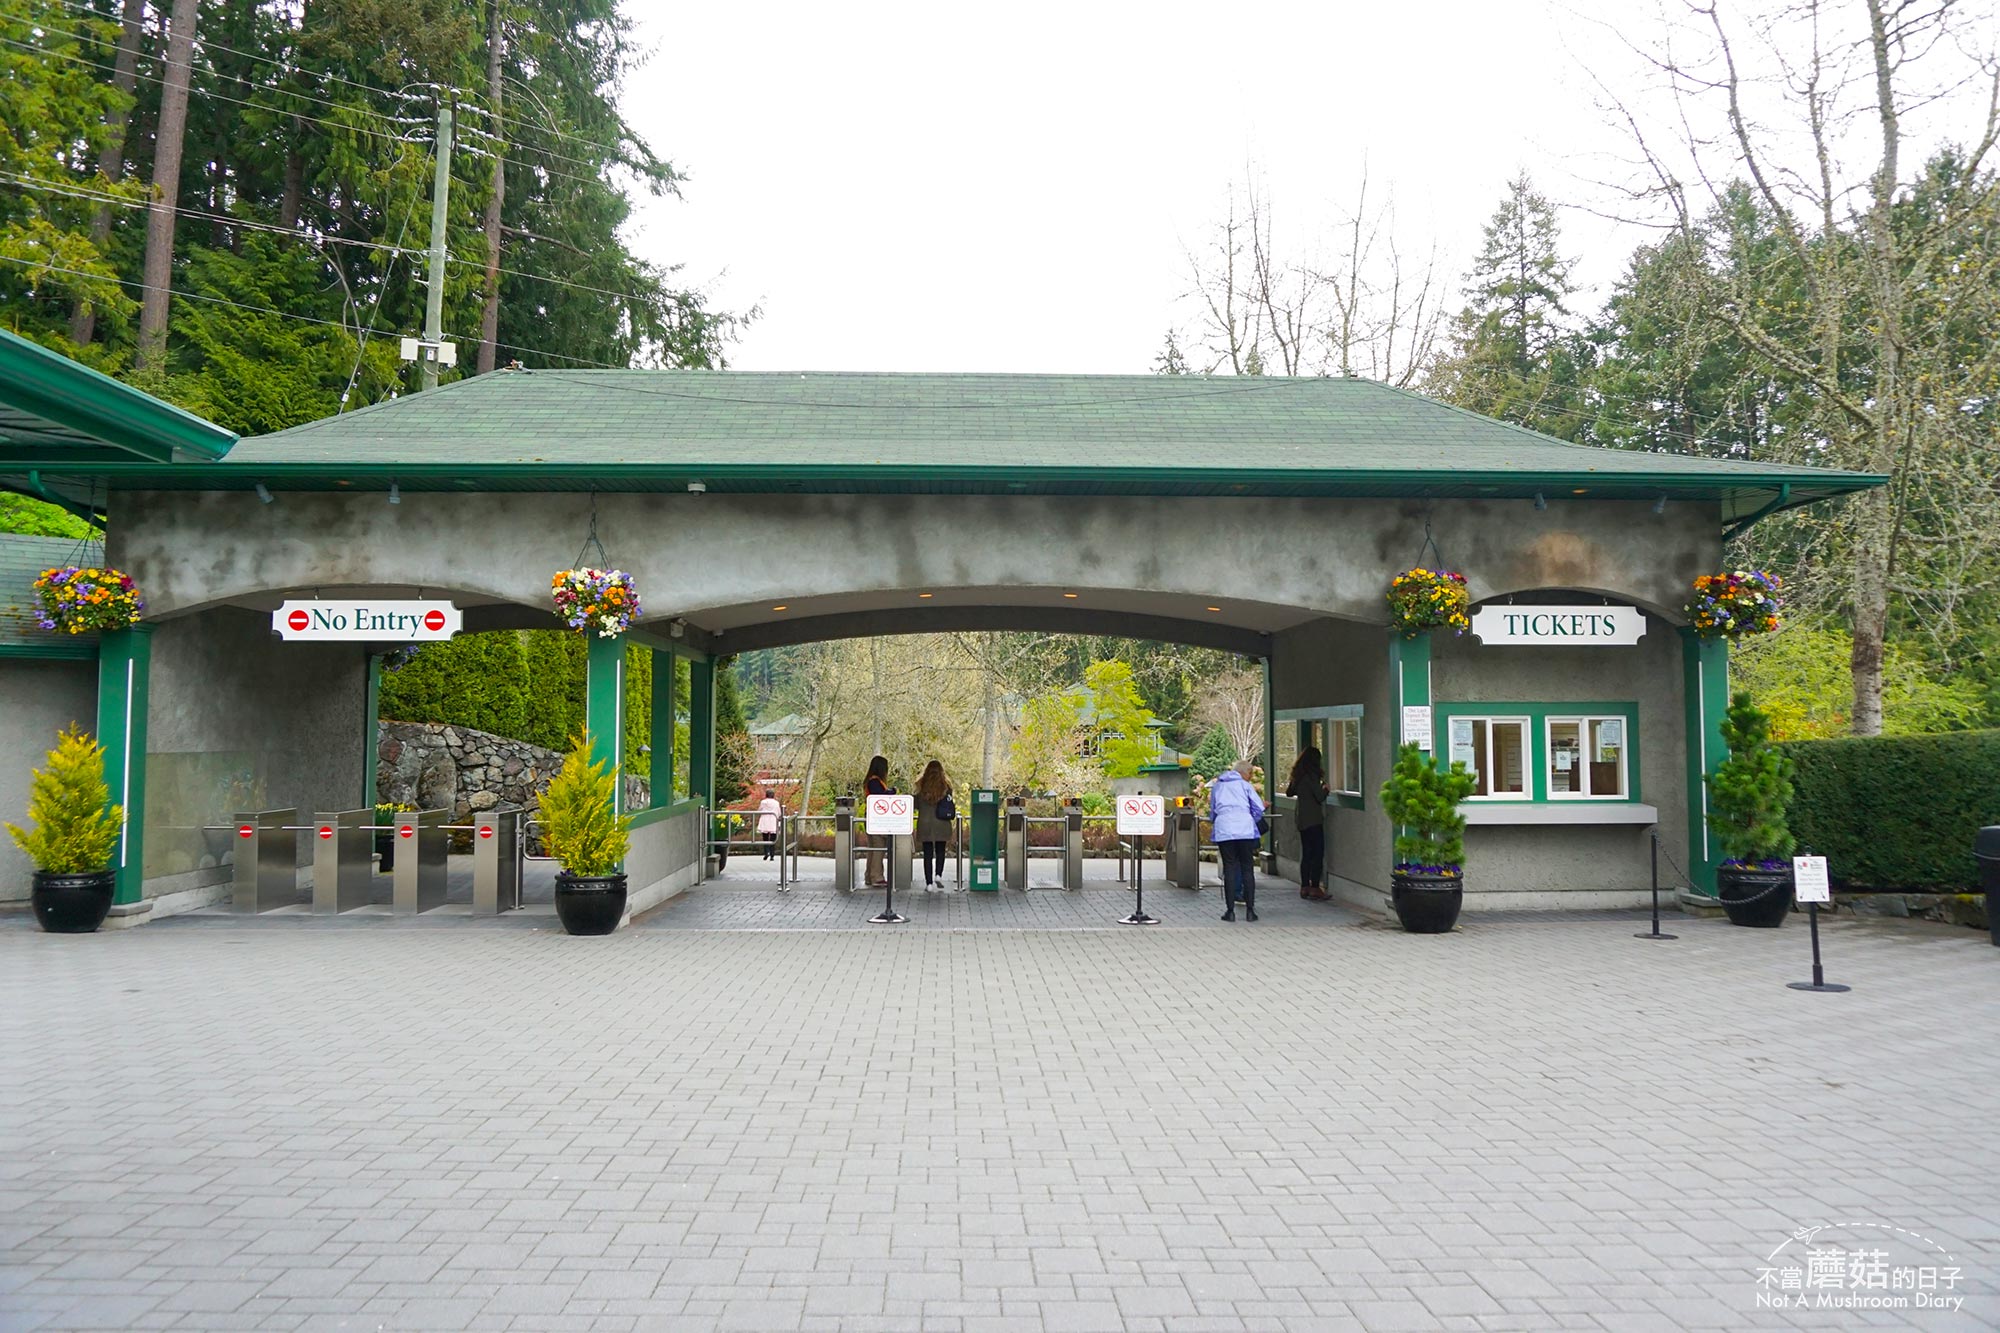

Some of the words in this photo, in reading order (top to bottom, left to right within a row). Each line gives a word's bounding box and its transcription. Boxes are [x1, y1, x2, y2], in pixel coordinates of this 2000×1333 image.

[311, 608, 347, 631] No
[353, 608, 424, 638] Entry
[1503, 614, 1616, 637] TICKETS
